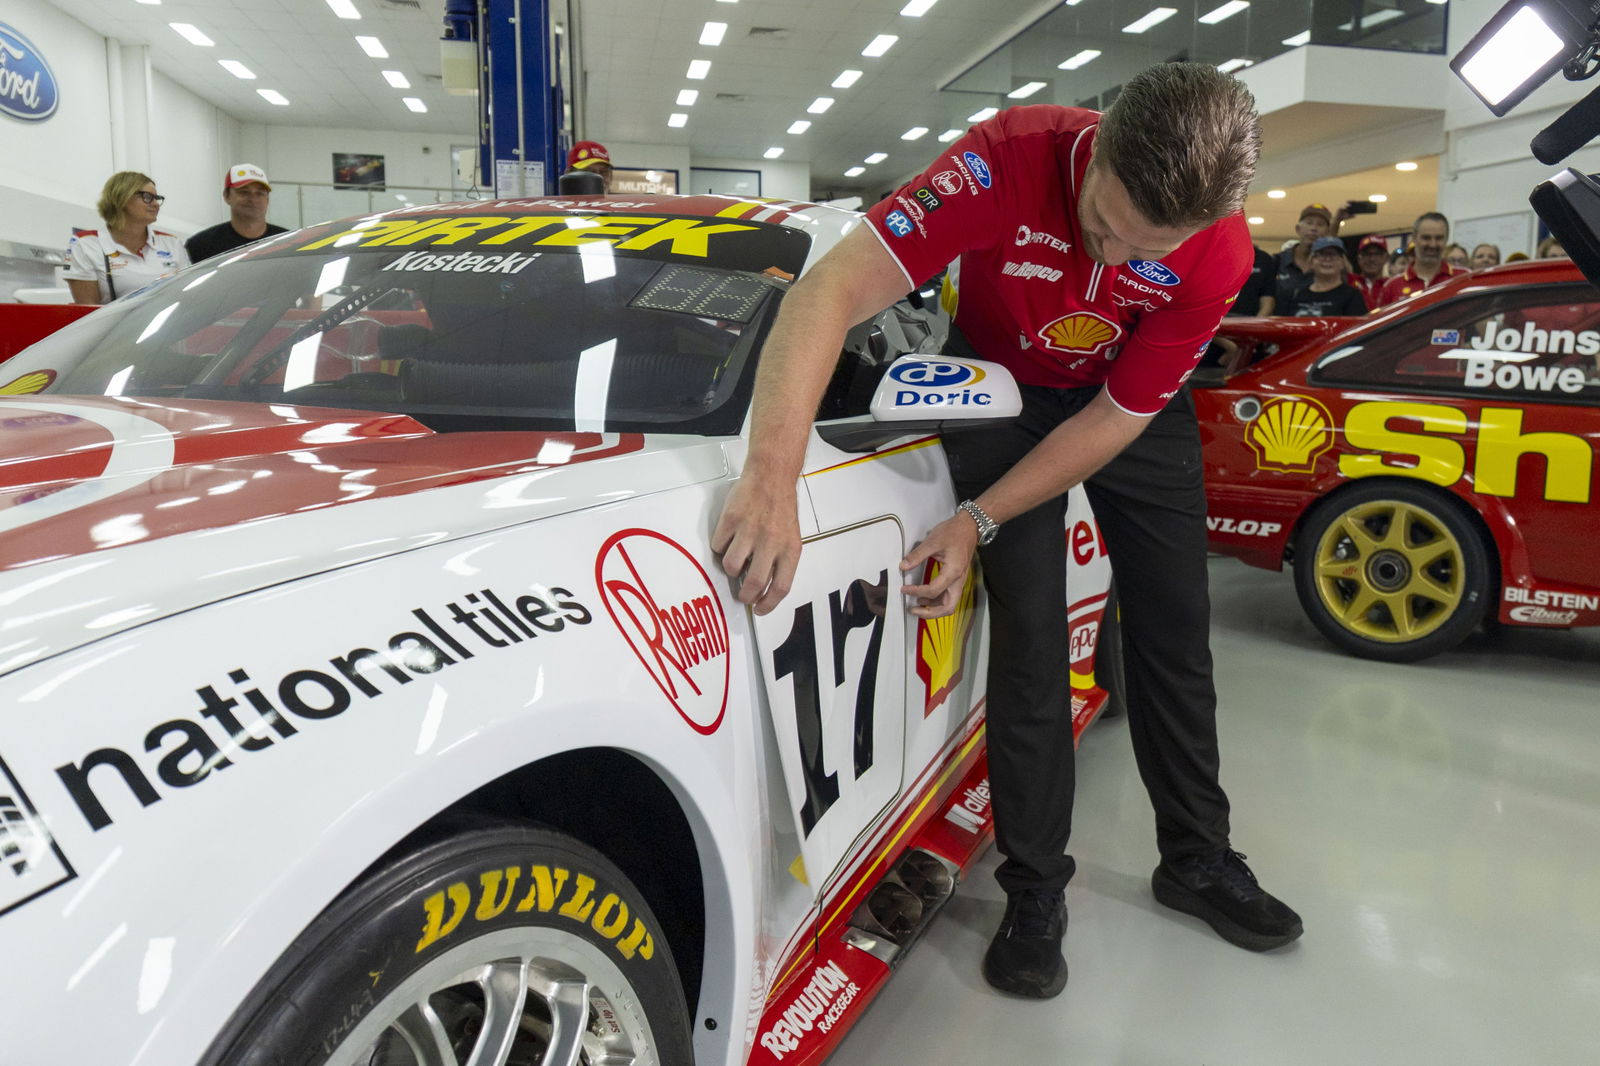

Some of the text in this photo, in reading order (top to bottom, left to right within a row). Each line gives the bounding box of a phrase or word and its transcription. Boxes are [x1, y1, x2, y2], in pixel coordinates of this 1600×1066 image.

[967, 156, 988, 180] Ford
[494, 199, 656, 210] V-Power
[916, 188, 938, 209] OTR
[296, 215, 761, 258] PIRTEK
[885, 211, 911, 235] PPG
[382, 251, 542, 274] Kostecki
[1014, 261, 1064, 282] Repco
[1136, 260, 1170, 283] Ford
[1117, 274, 1174, 302] RACING
[1464, 357, 1585, 393] Bowe
[895, 389, 992, 406] Doric
[1338, 401, 1593, 503] Sh
[1206, 516, 1282, 537] NLOP
[1504, 586, 1599, 611] BILSTEIN
[604, 542, 726, 700] Rheem
[1070, 627, 1096, 658] PPG
[53, 585, 593, 832] national tiles
[773, 568, 888, 841] 17
[416, 865, 654, 960] DUNLOP
[760, 959, 849, 1061] REVOLUTION
[817, 982, 861, 1034] RACEGEAR
